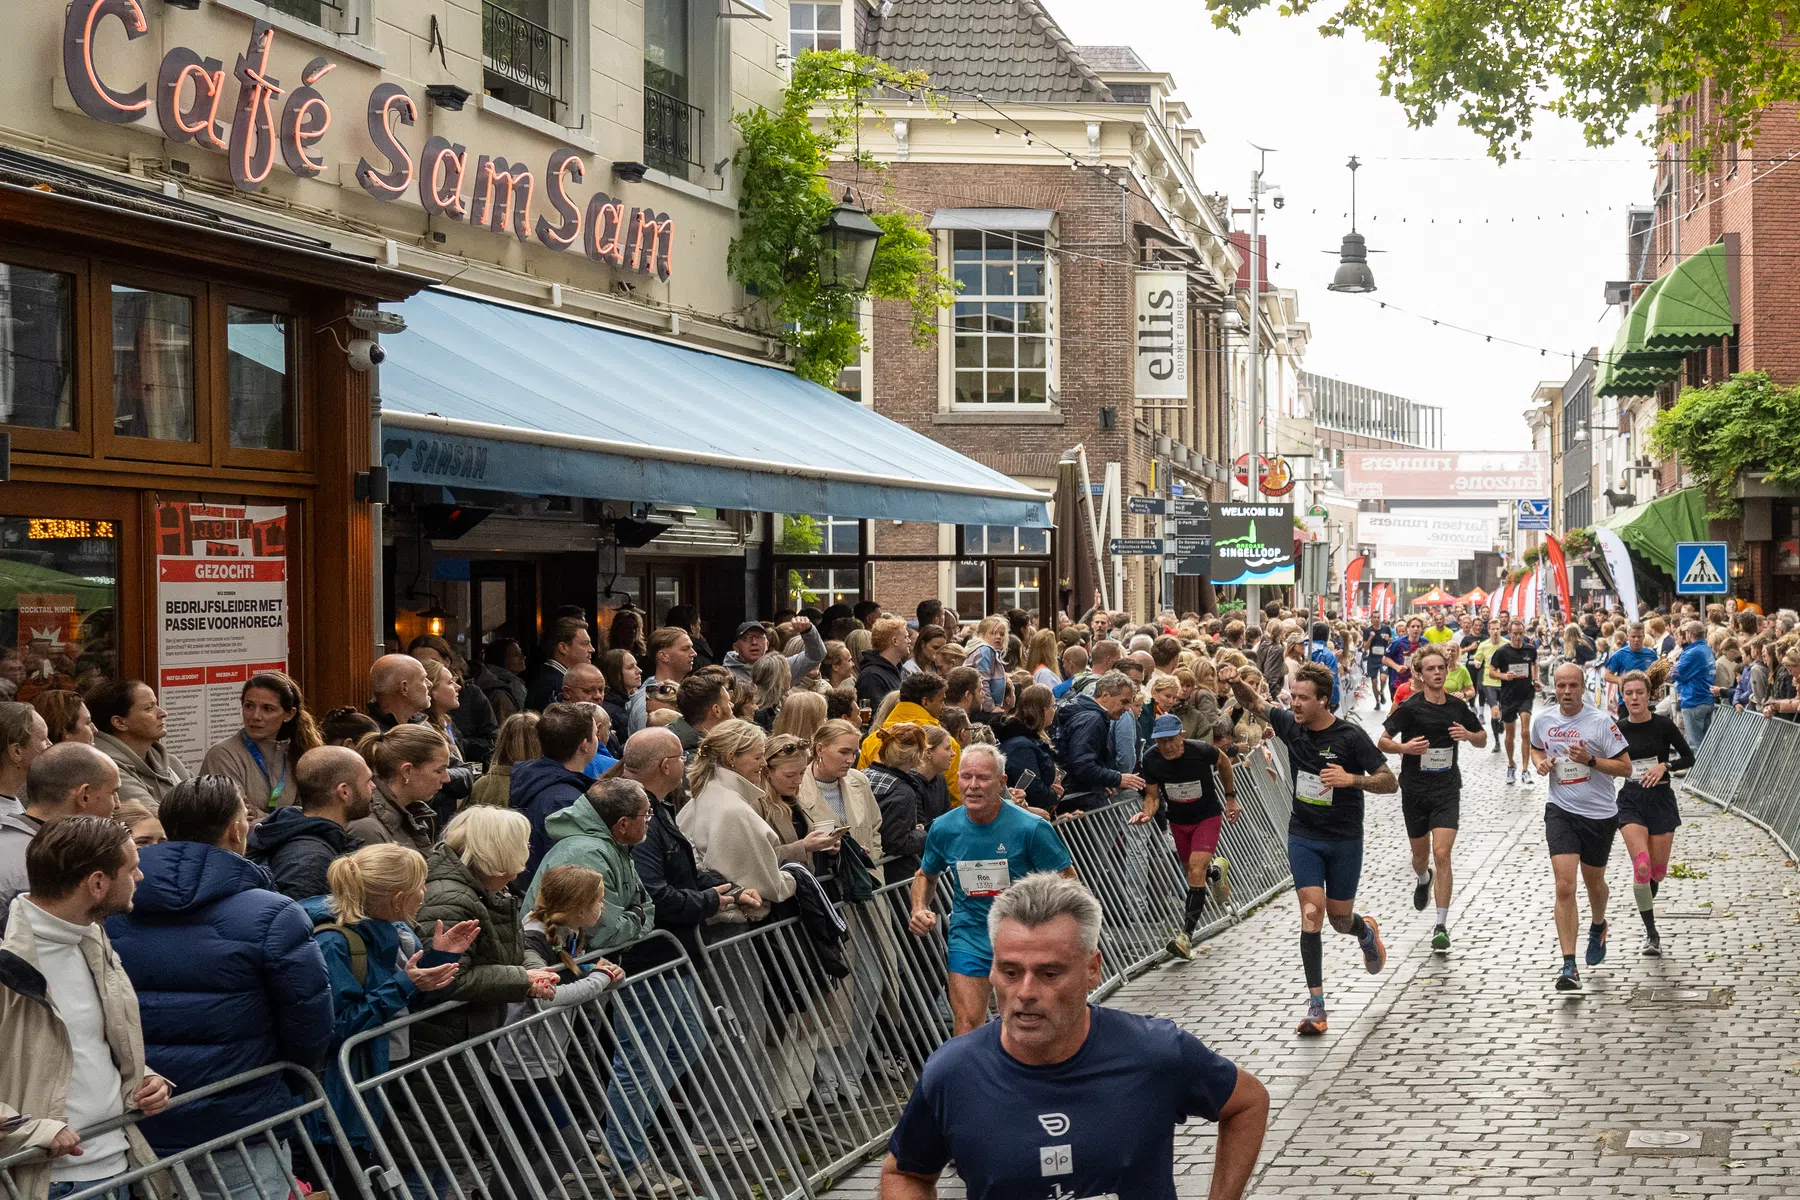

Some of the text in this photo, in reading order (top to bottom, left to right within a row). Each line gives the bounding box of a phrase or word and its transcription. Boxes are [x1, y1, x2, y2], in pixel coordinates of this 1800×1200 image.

[63, 0, 337, 191] Café
[1138, 289, 1174, 381] ellis
[1177, 290, 1185, 381] GOURMET BURGER
[411, 439, 488, 480] SAMSAM
[1220, 507, 1284, 517] WELKOM BIJ
[1219, 547, 1282, 558] SINGELLOOP
[194, 563, 255, 579] GEZOCHT!
[20, 606, 53, 614] COCKTAIL
[166, 599, 283, 614] BEDRIJFSLEIDER MET
[165, 615, 283, 631] PASSIE VOOR HORECA
